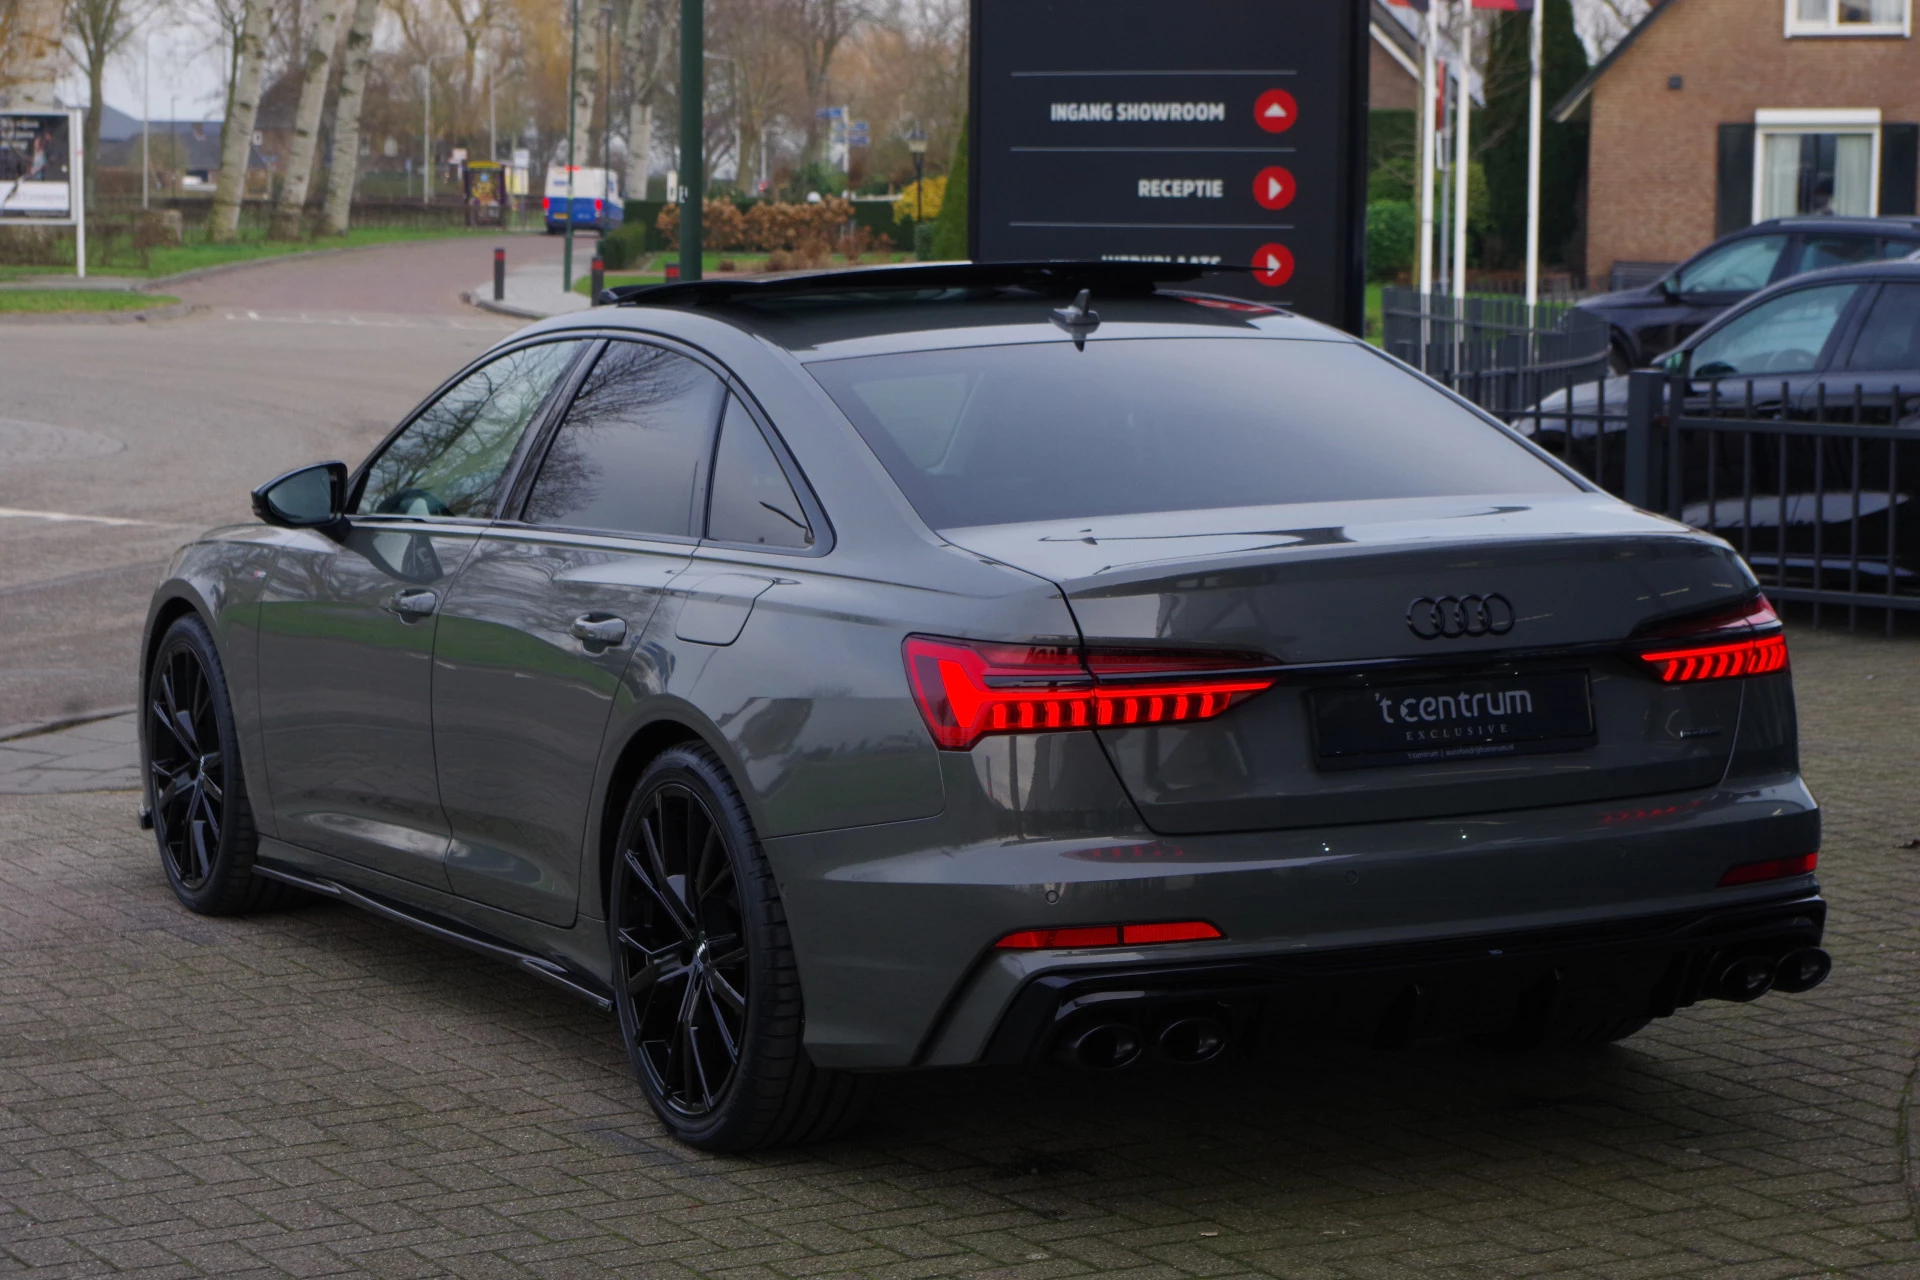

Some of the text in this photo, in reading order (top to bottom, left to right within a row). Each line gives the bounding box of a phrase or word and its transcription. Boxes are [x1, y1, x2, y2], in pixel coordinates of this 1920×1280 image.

[1050, 102, 1225, 122] INGANG SHOWROOM
[1138, 179, 1223, 198] RECEPTIE
[1400, 689, 1533, 723] centrum
[1406, 723, 1508, 741] EXCLUSIVE
